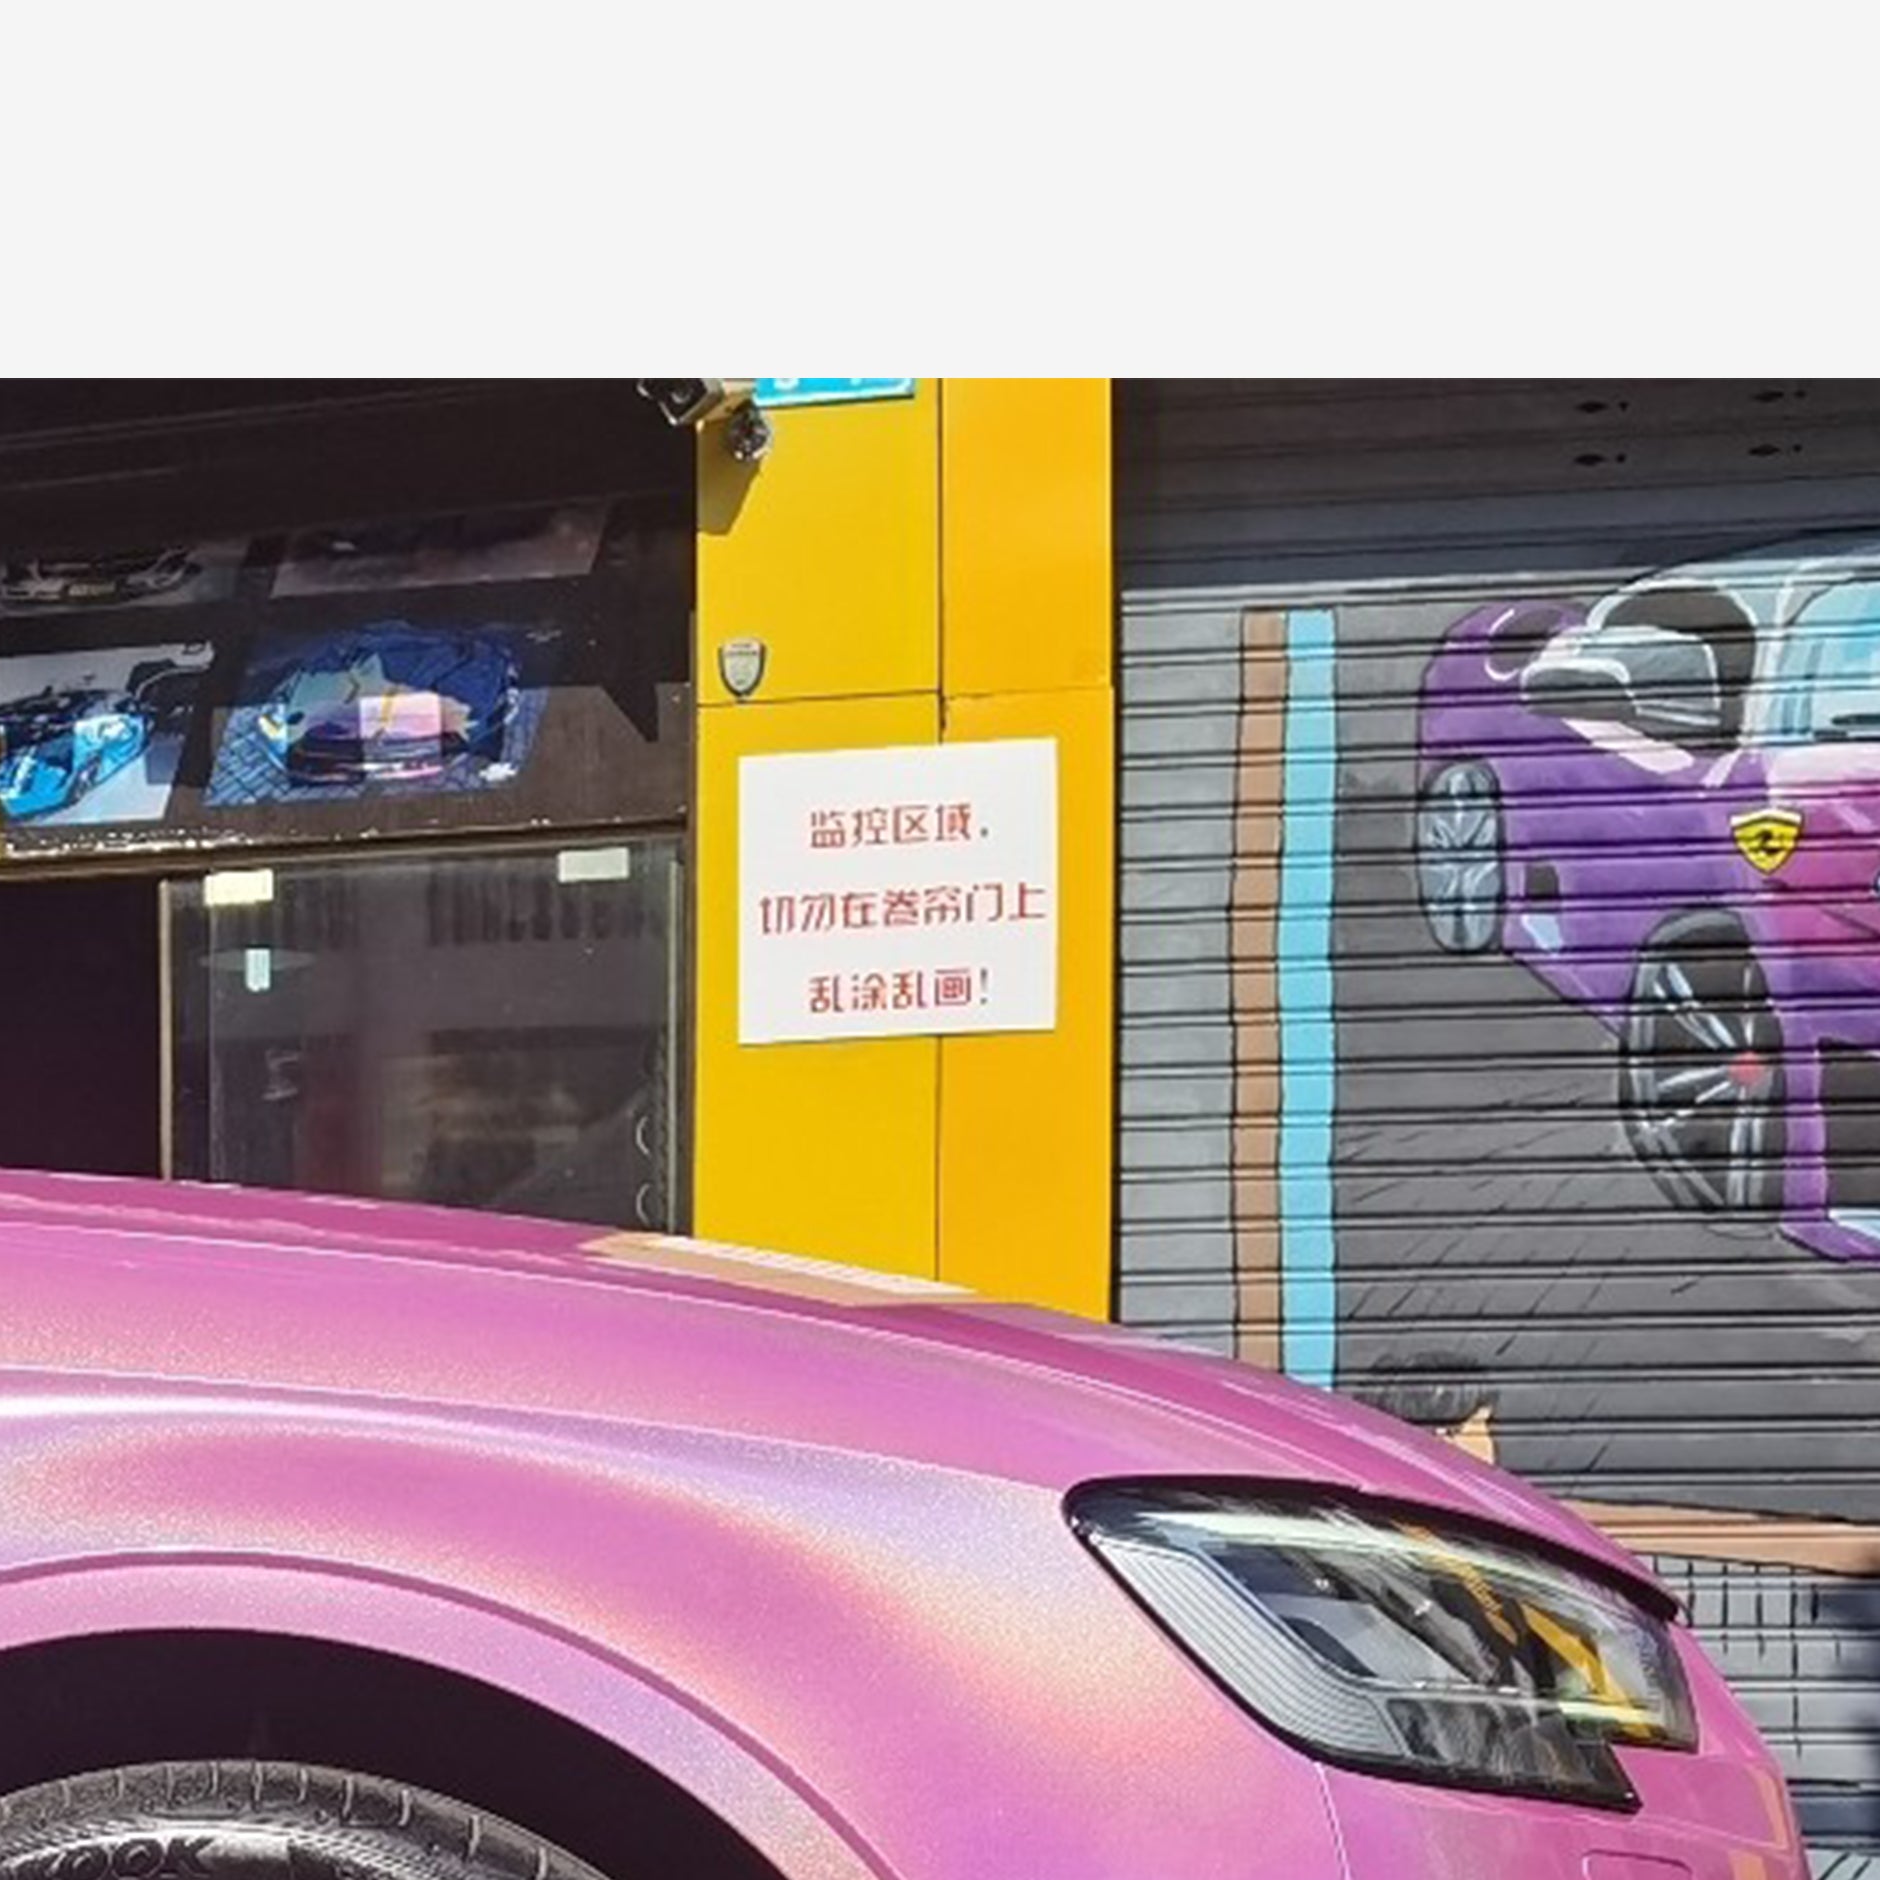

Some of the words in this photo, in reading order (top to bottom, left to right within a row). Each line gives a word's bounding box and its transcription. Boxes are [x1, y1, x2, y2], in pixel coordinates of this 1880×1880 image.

[758, 881, 1048, 935] 切勿在卷帘门上
